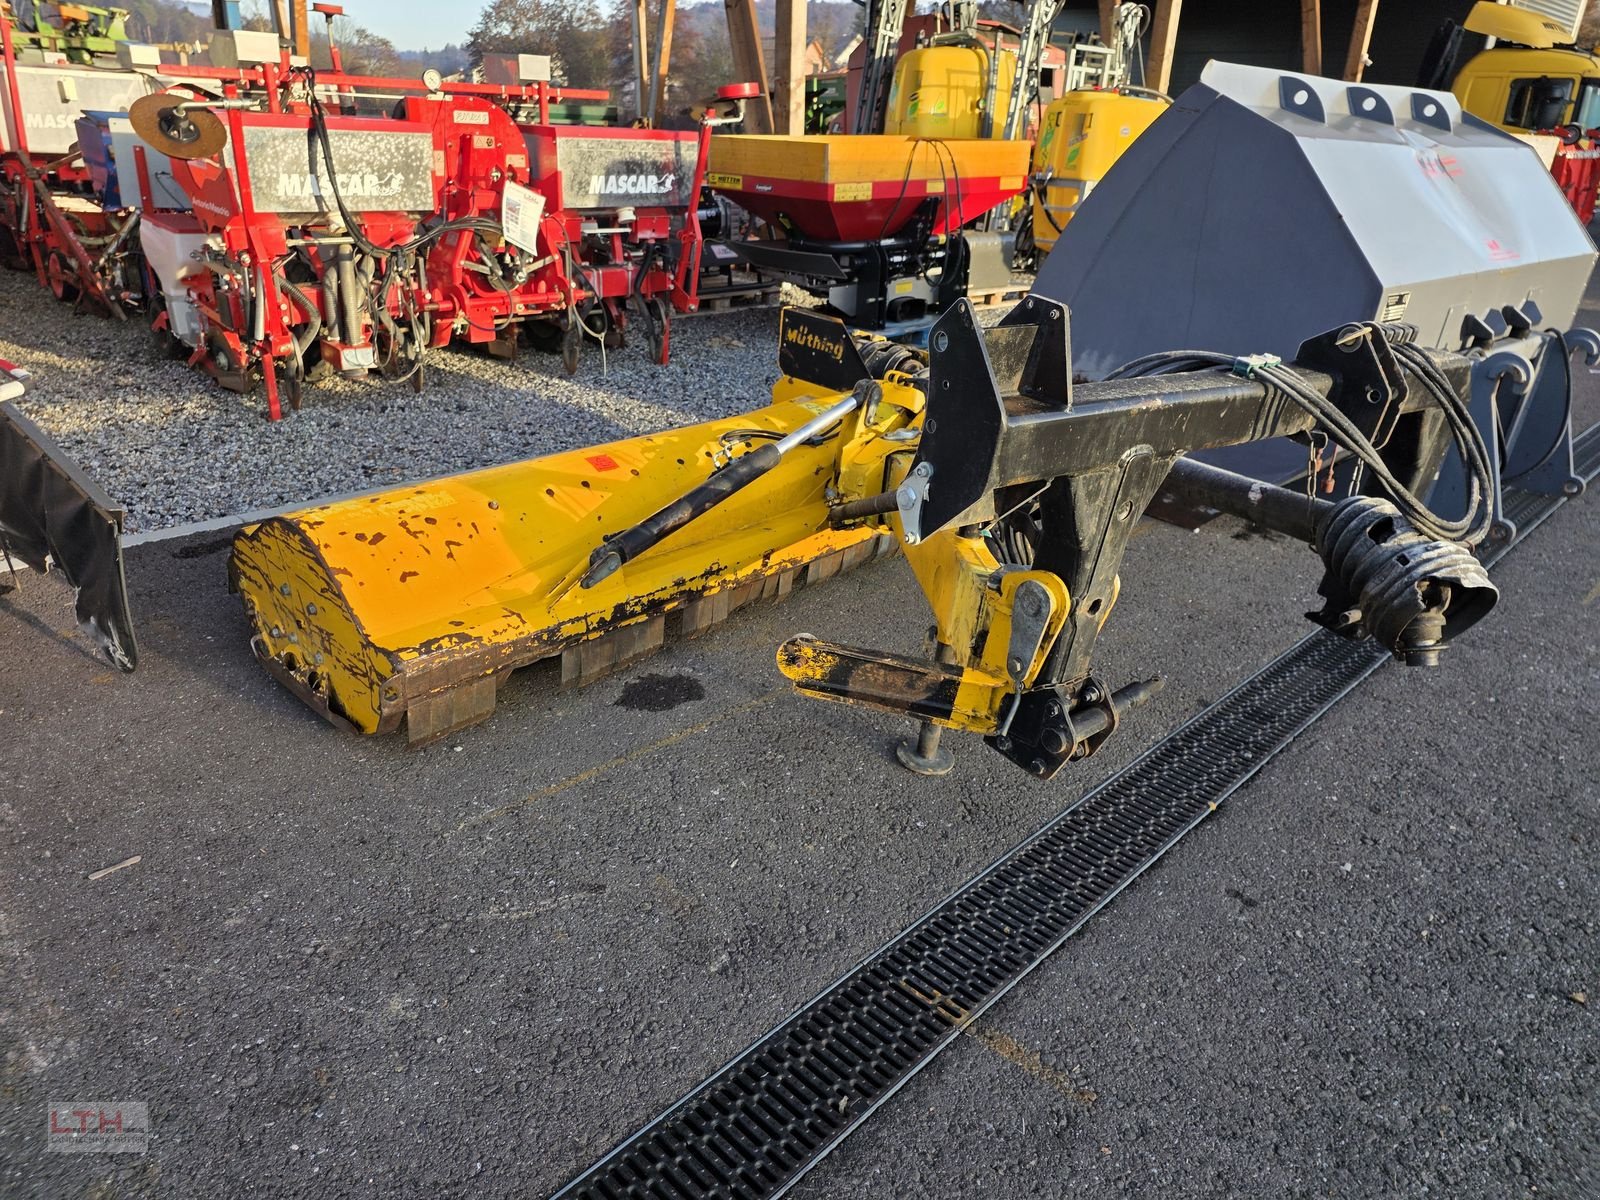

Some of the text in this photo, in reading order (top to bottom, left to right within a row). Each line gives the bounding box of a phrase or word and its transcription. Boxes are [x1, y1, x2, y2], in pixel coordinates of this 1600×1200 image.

[278, 173, 380, 196] MASCAR
[588, 175, 659, 194] MASCAR
[787, 324, 844, 360] Müthing
